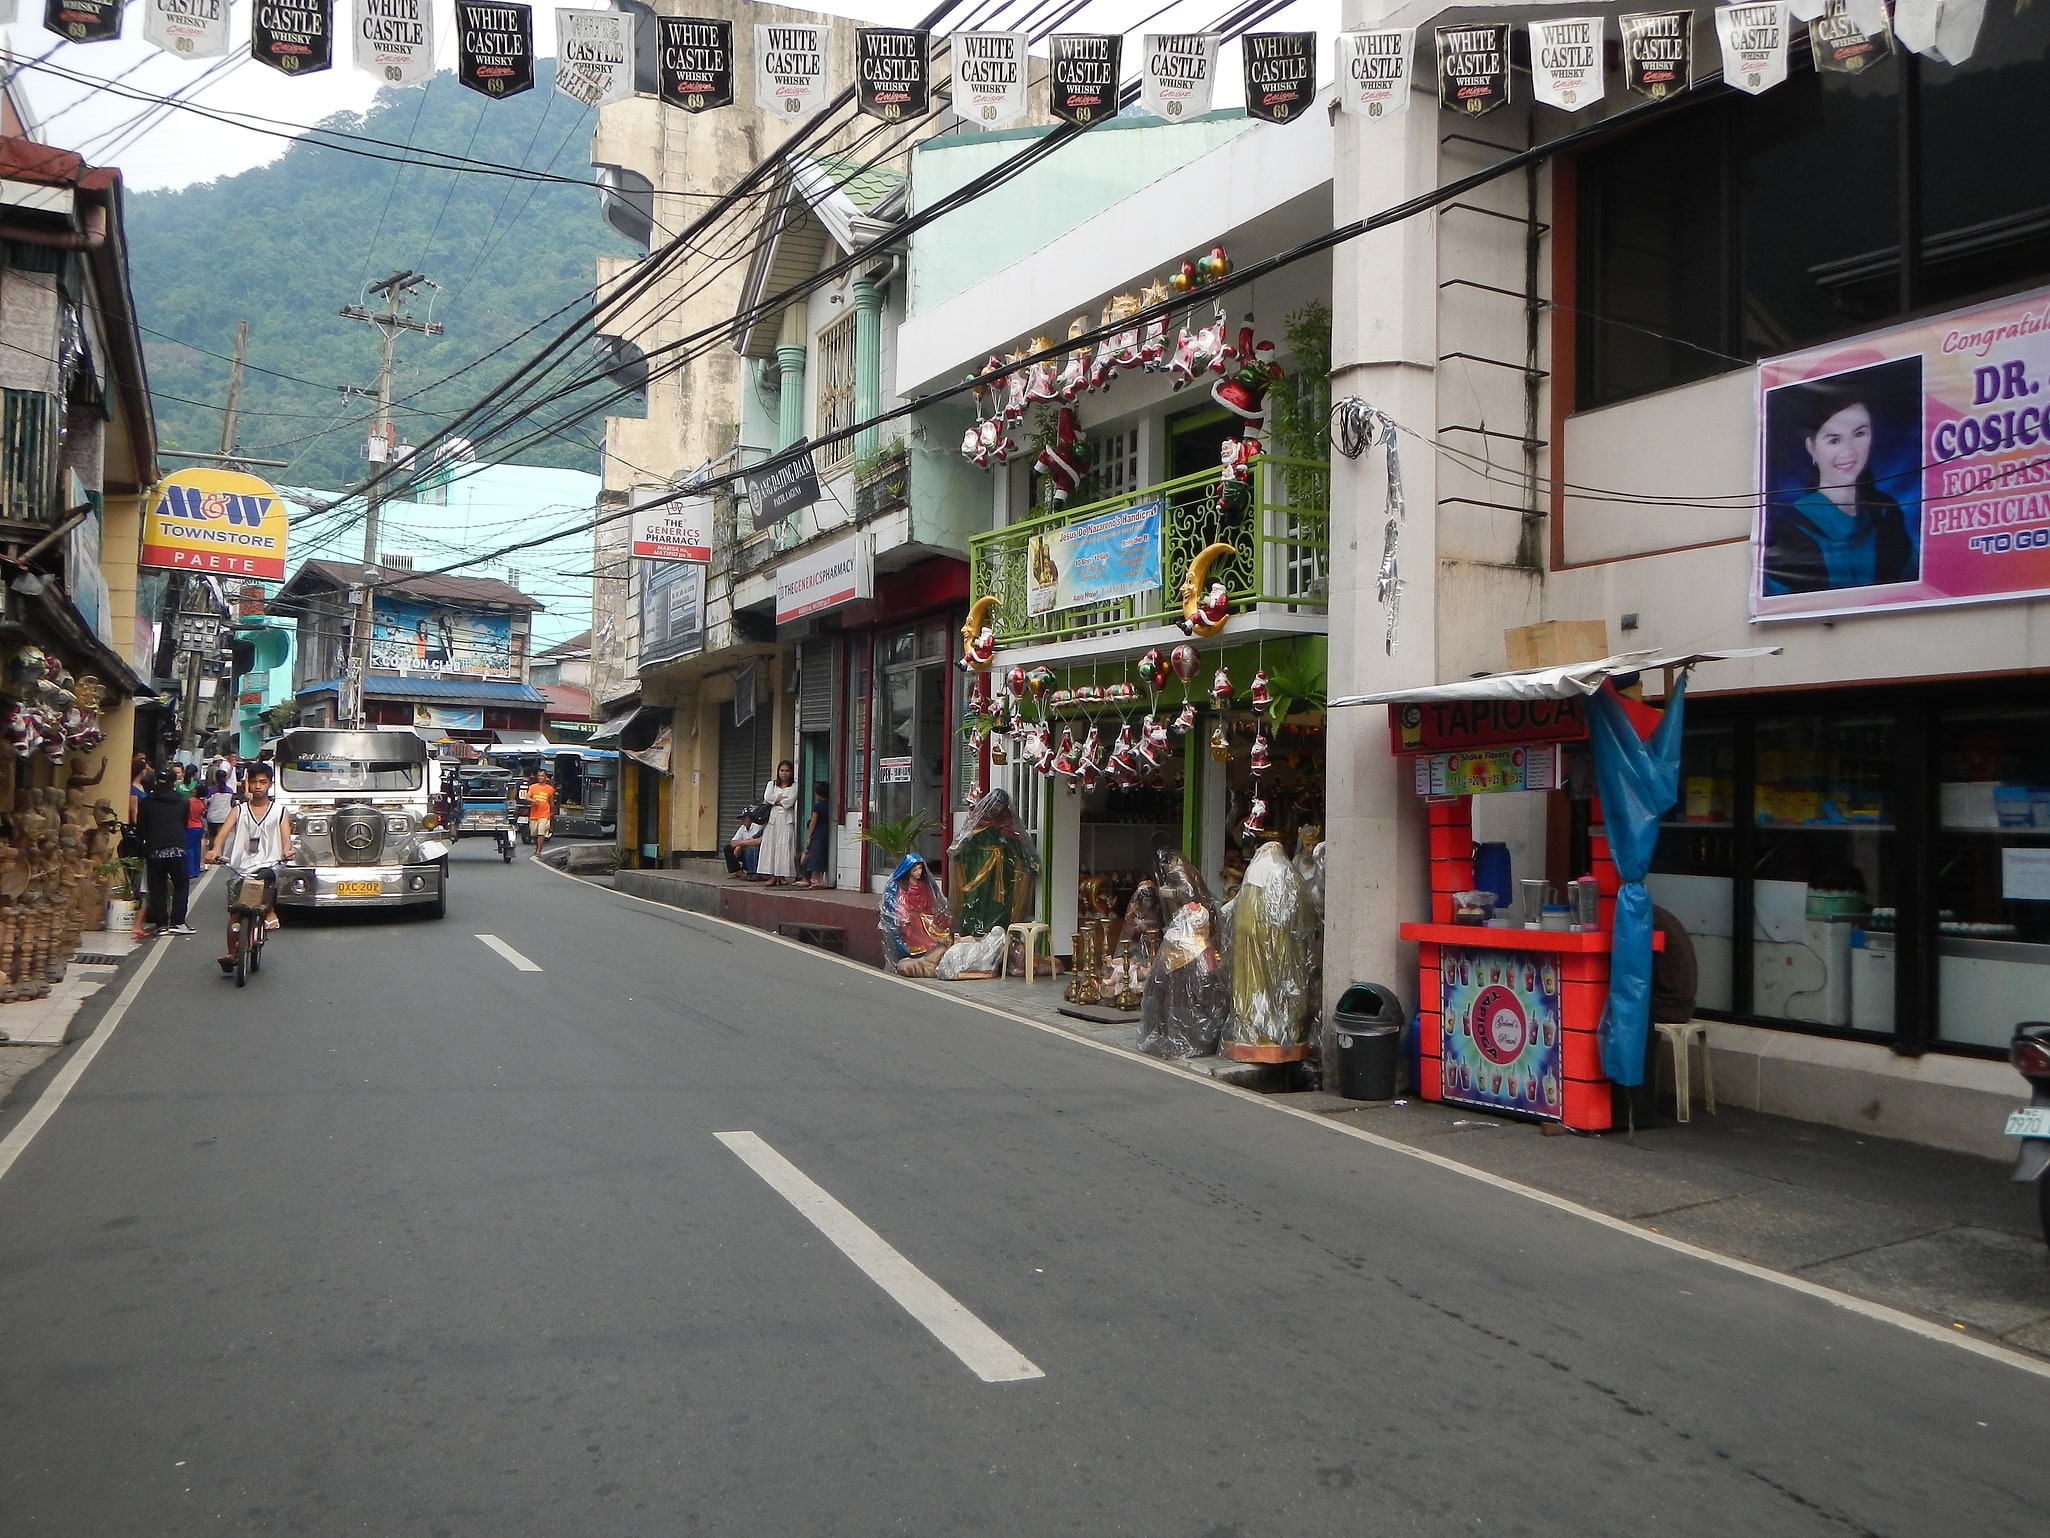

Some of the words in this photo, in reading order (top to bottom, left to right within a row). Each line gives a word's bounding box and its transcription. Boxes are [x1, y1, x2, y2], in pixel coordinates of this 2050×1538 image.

[366, 0, 418, 20] WHITE
[466, 7, 518, 32] WHITE
[1729, 5, 1777, 28] WHITE
[167, 13, 208, 29] WHISKY
[260, 7, 322, 36] CASTLE
[363, 17, 423, 45] CASTLE
[1631, 16, 1679, 38] WHITE
[271, 30, 311, 45] WHISKY
[466, 32, 523, 56] CASTLE
[668, 23, 719, 47] WHITE
[767, 29, 817, 51] WHITE
[1446, 29, 1496, 54] WHITE
[1541, 23, 1590, 45] WHITE
[1730, 28, 1779, 51] CASTLE
[373, 42, 413, 54] WHISKY
[865, 34, 916, 57] WHITE
[964, 36, 1014, 59] WHITE
[1059, 38, 1109, 60] WHITE
[1157, 36, 1205, 56] WHITE
[1253, 36, 1302, 58] WHITE
[1354, 34, 1401, 55] WHITE
[1633, 39, 1682, 61] CASTLE
[281, 55, 299, 70] 69
[475, 55, 514, 66] WHISKY
[666, 49, 724, 72] CASTLE
[765, 52, 820, 75] CASTLE
[1446, 53, 1499, 77] CASTLE
[1541, 47, 1593, 69] CASTLE
[1641, 61, 1674, 71] WHISKY
[1740, 51, 1770, 61] WHISKY
[384, 66, 402, 81] 69
[676, 71, 715, 82] WHISKY
[863, 59, 920, 82] CASTLE
[961, 60, 1017, 83] CASTLE
[1057, 61, 1111, 84] CASTLE
[1151, 54, 1206, 80] CASTLE
[1251, 58, 1307, 83] CASTLE
[1351, 57, 1403, 79] CASTLE
[1550, 69, 1585, 79] WHISKY
[487, 79, 504, 92] 69
[774, 76, 811, 86] WHISKY
[873, 82, 910, 92] WHISKY
[971, 84, 1007, 93] WHISKY
[1066, 84, 1102, 95] WHISKY
[1159, 78, 1195, 89] WHISKY
[1261, 81, 1298, 92] WHISKY
[1360, 81, 1393, 90] WHISKY
[1456, 76, 1491, 86] WHISKY
[1652, 83, 1666, 97] 69
[688, 94, 704, 108] 69
[785, 98, 801, 112] 69
[884, 104, 901, 118] 69
[1166, 101, 1182, 115] 69
[1272, 104, 1289, 118] 69
[1368, 102, 1383, 116] 69
[1466, 98, 1482, 113] 69
[981, 105, 997, 120] 69
[1076, 107, 1091, 121] 69
[1972, 360, 2039, 405] DR.
[1944, 467, 1994, 497] FOR
[155, 485, 272, 527] M&W
[647, 526, 700, 537] GENERICS
[664, 519, 683, 527] THE
[160, 523, 275, 548] TOWNSTORE
[646, 534, 699, 545] PHARMACY
[1060, 531, 1077, 542] Jesus
[1078, 526, 1087, 537] De
[174, 551, 254, 572] PAETE
[1477, 991, 1500, 1060] TAPIOCA
